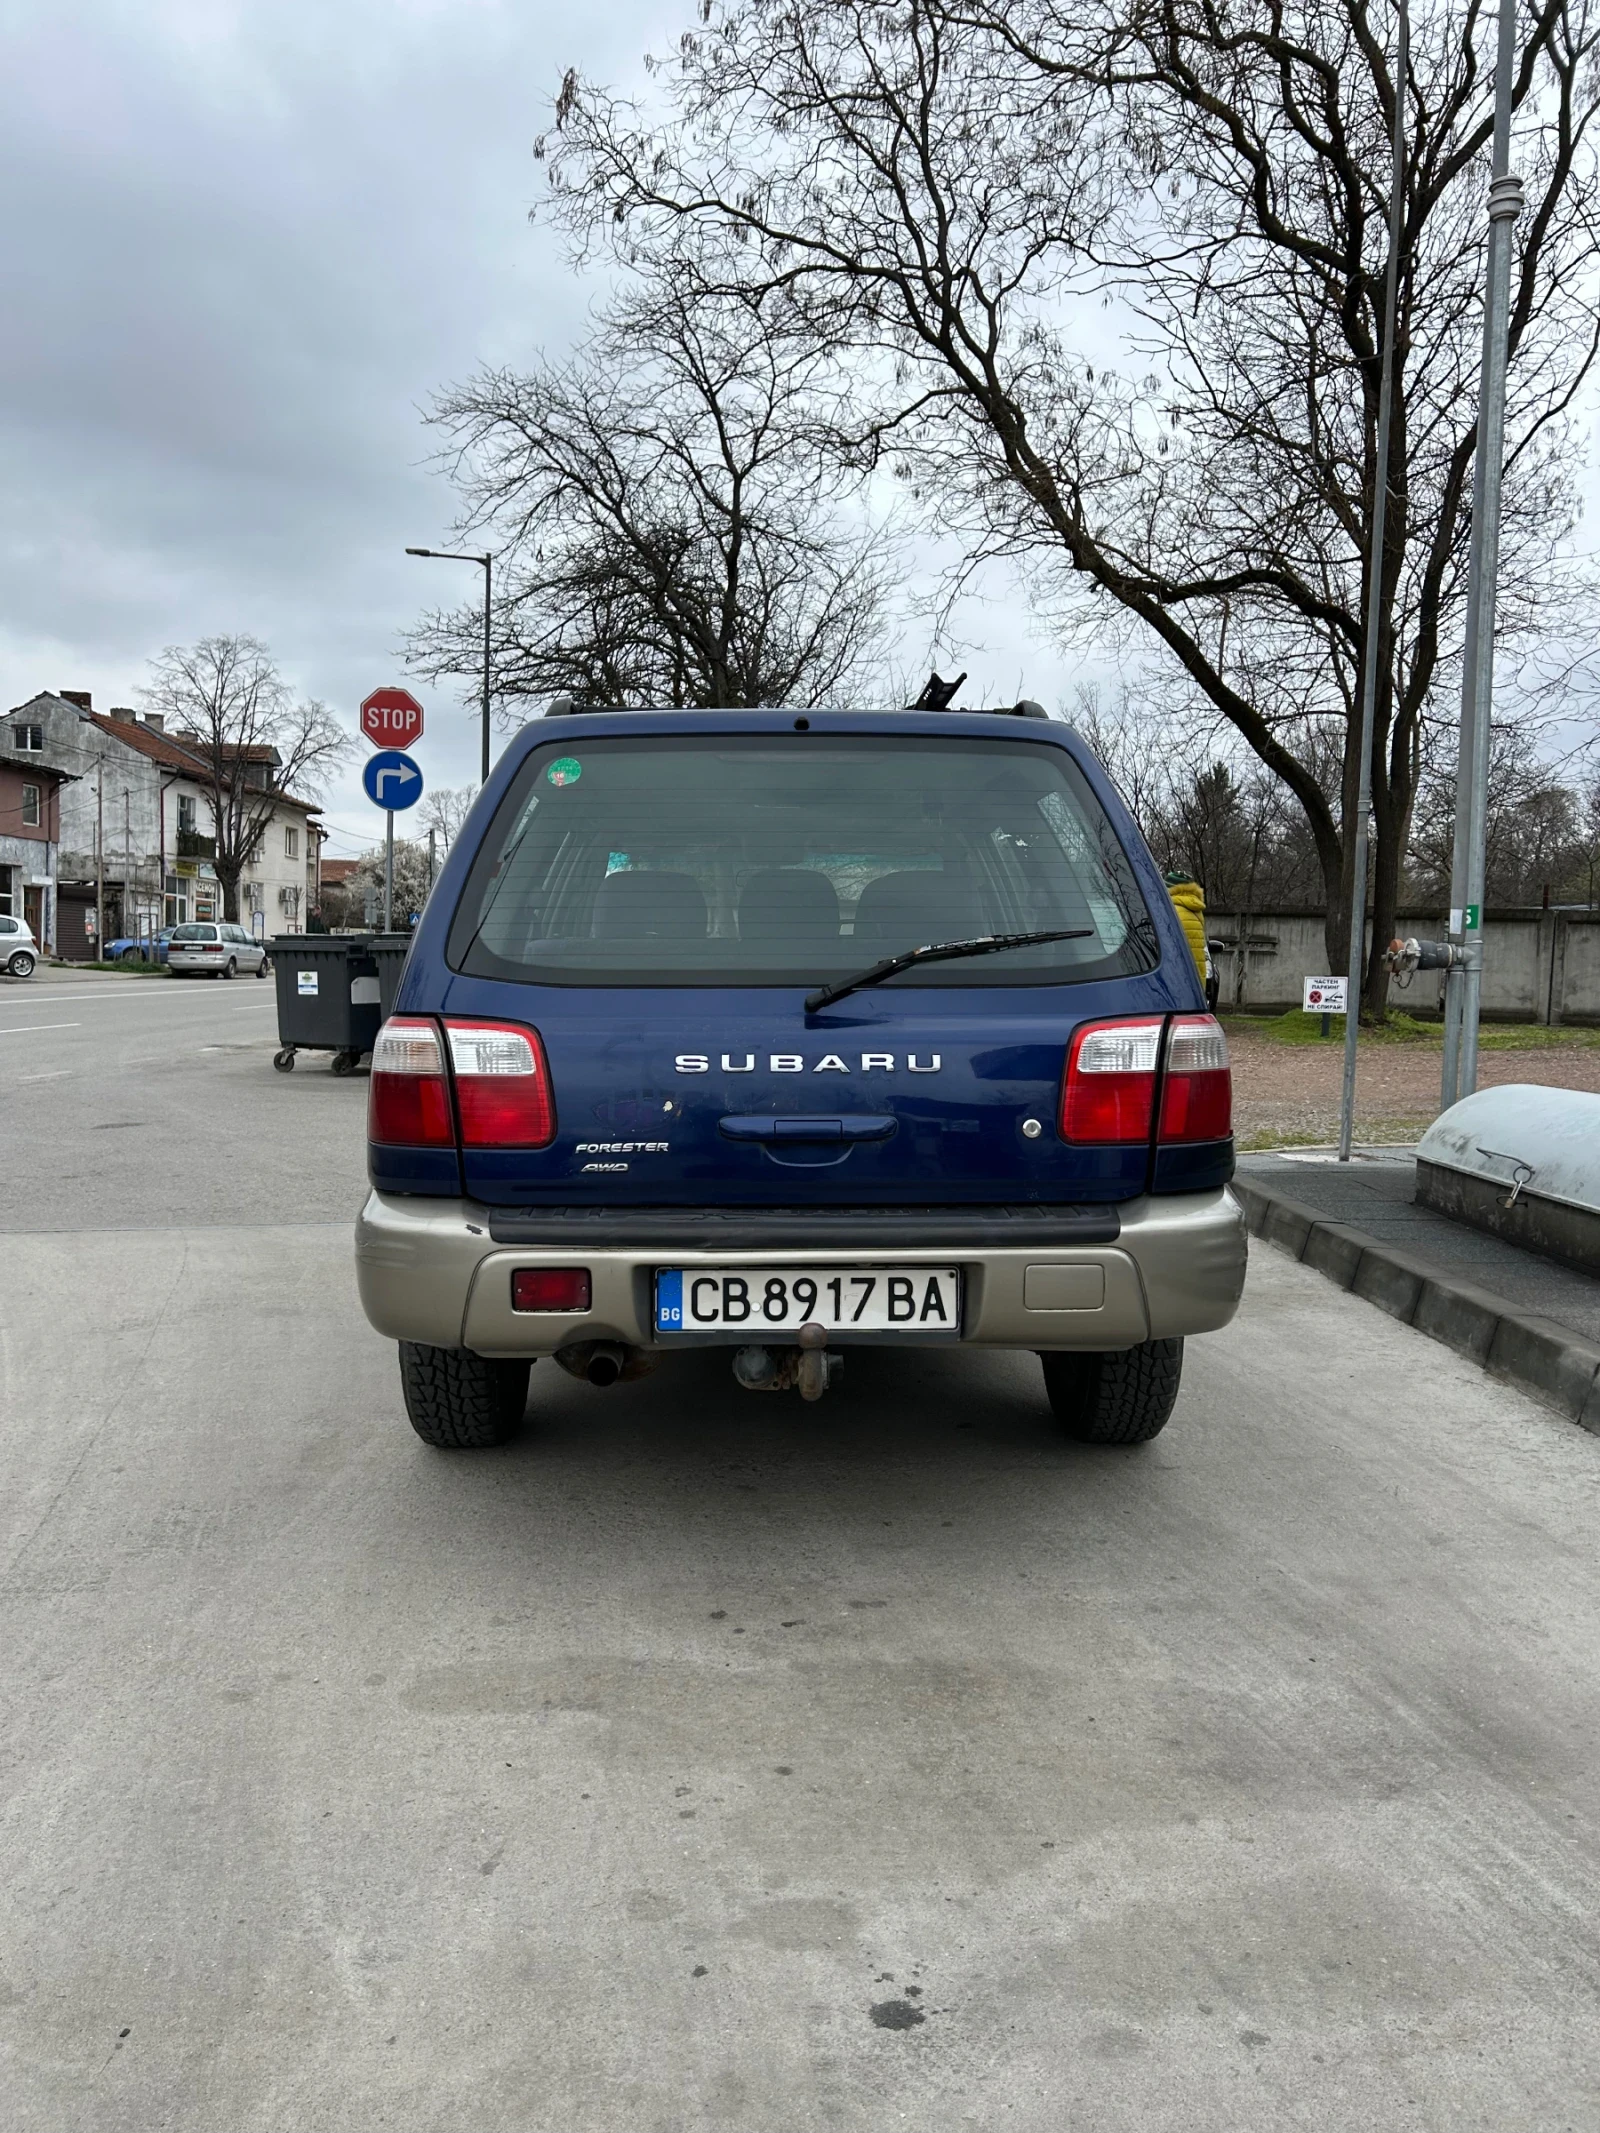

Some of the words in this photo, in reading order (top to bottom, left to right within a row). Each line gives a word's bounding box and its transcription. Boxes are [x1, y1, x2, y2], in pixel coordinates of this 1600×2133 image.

[367, 707, 417, 730] STOP
[675, 1053, 941, 1073] SUBARU
[575, 1142, 669, 1154] FORESTER
[581, 1163, 629, 1172] AWD
[691, 1277, 750, 1322] CB
[763, 1277, 876, 1322] 8917
[888, 1276, 947, 1322] BA
[660, 1307, 681, 1321] BG
